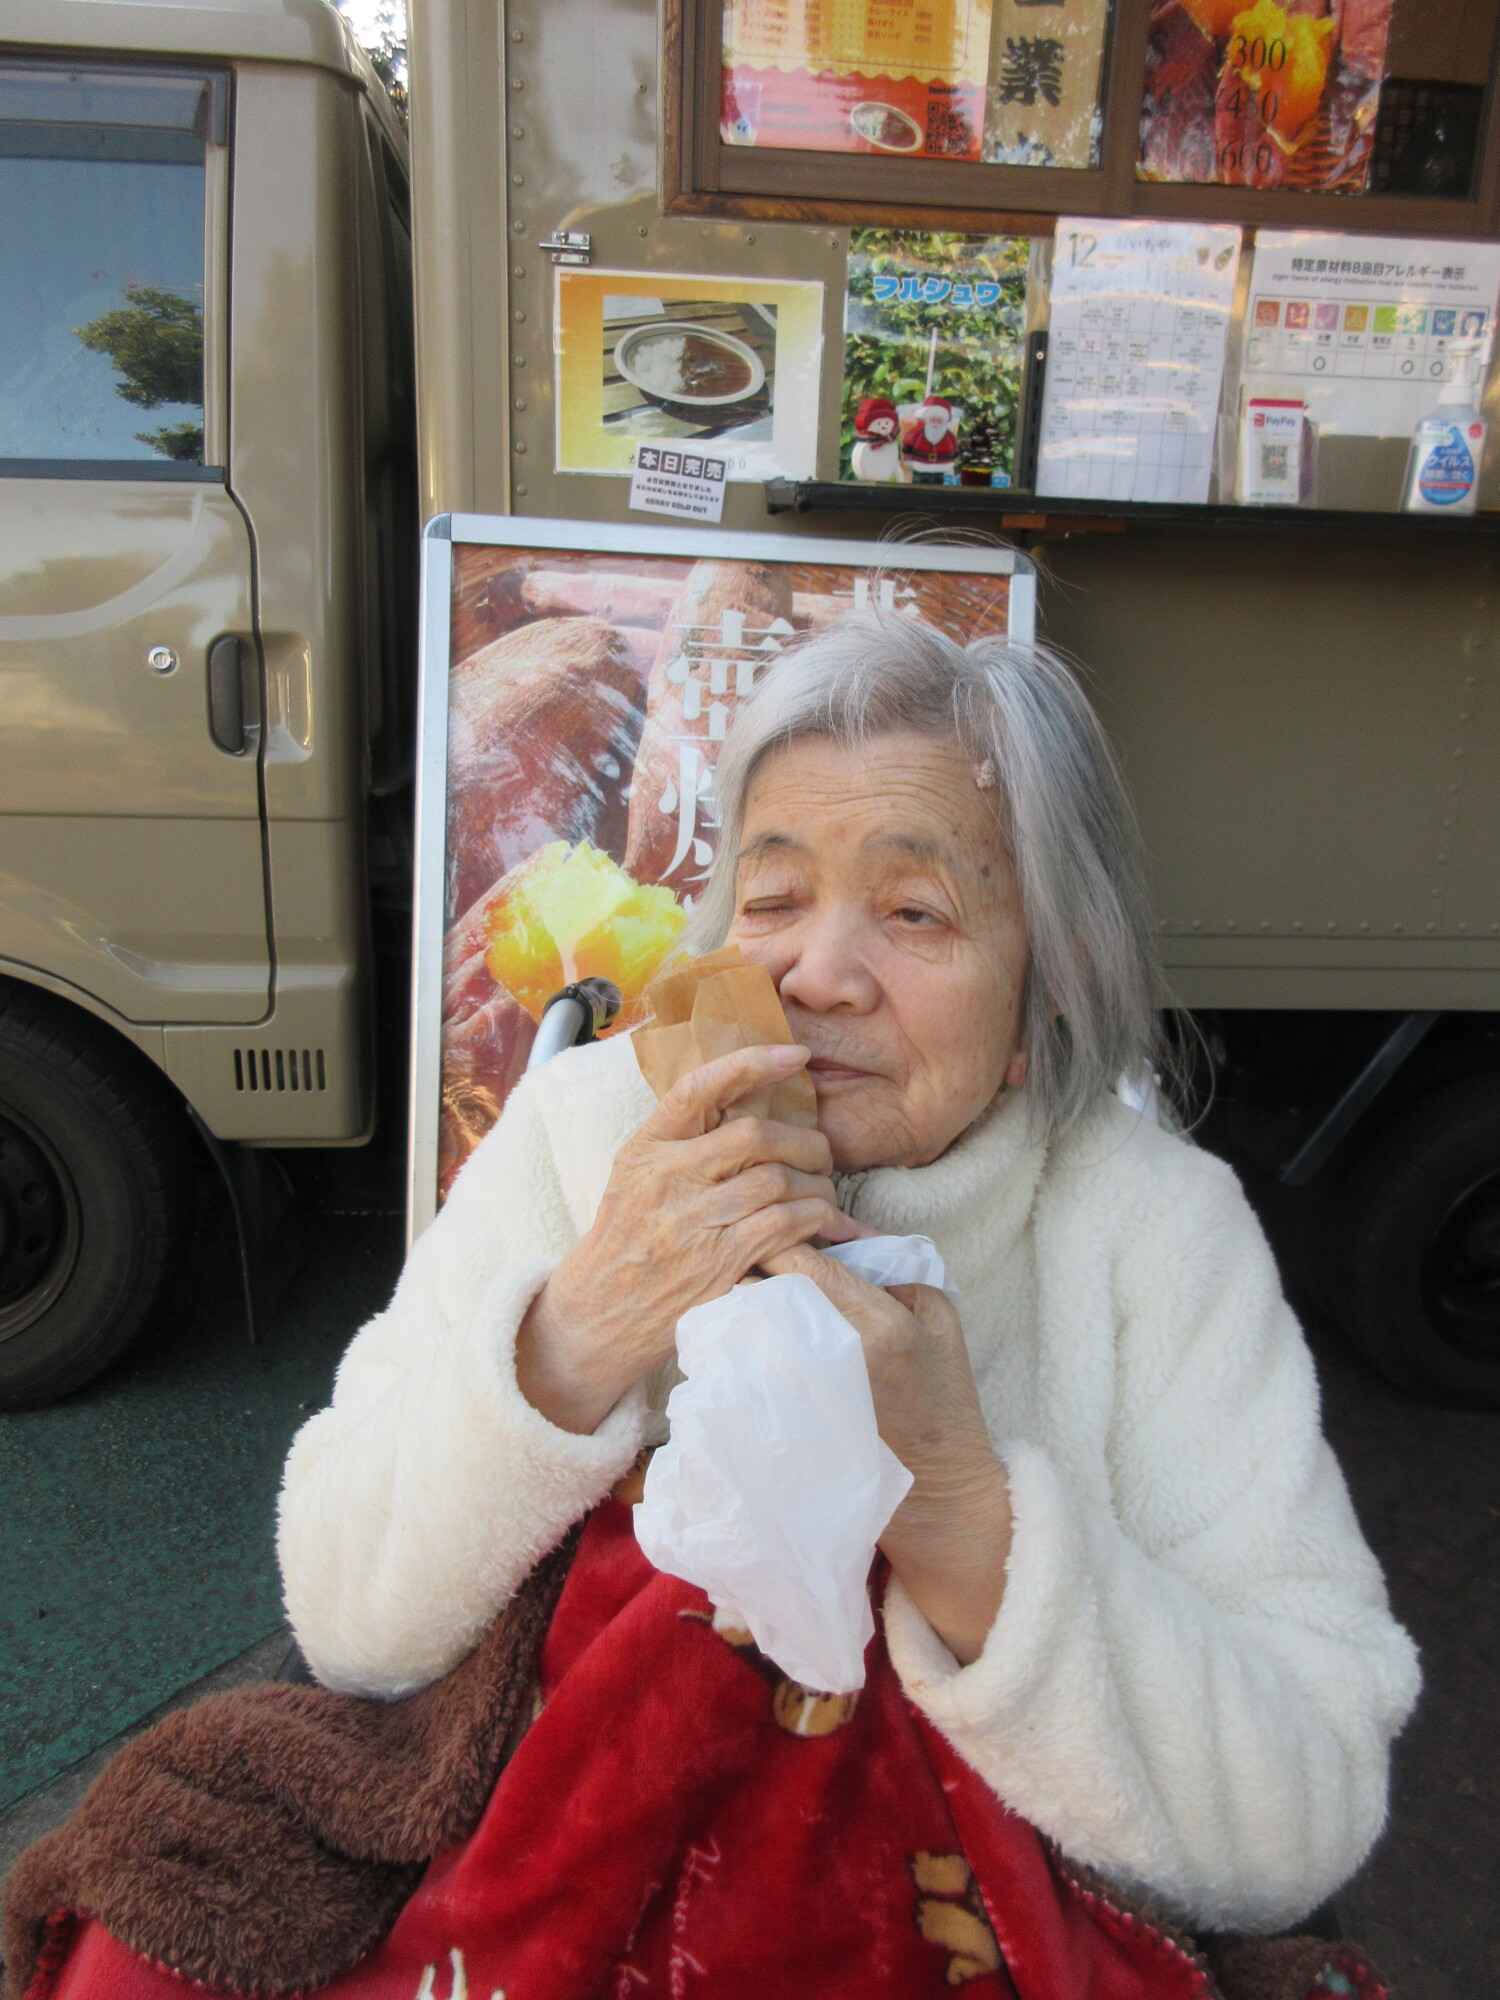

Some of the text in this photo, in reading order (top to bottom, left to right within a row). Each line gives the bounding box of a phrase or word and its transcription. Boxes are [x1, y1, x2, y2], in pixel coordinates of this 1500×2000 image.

[1231, 36, 1286, 72] 300
[1068, 233, 1097, 268] 12
[873, 276, 1002, 306] フルシュワ
[1265, 415, 1296, 428] PayPay
[640, 451, 723, 480] 本日完売
[645, 497, 708, 514] SORRY SOLD OUT
